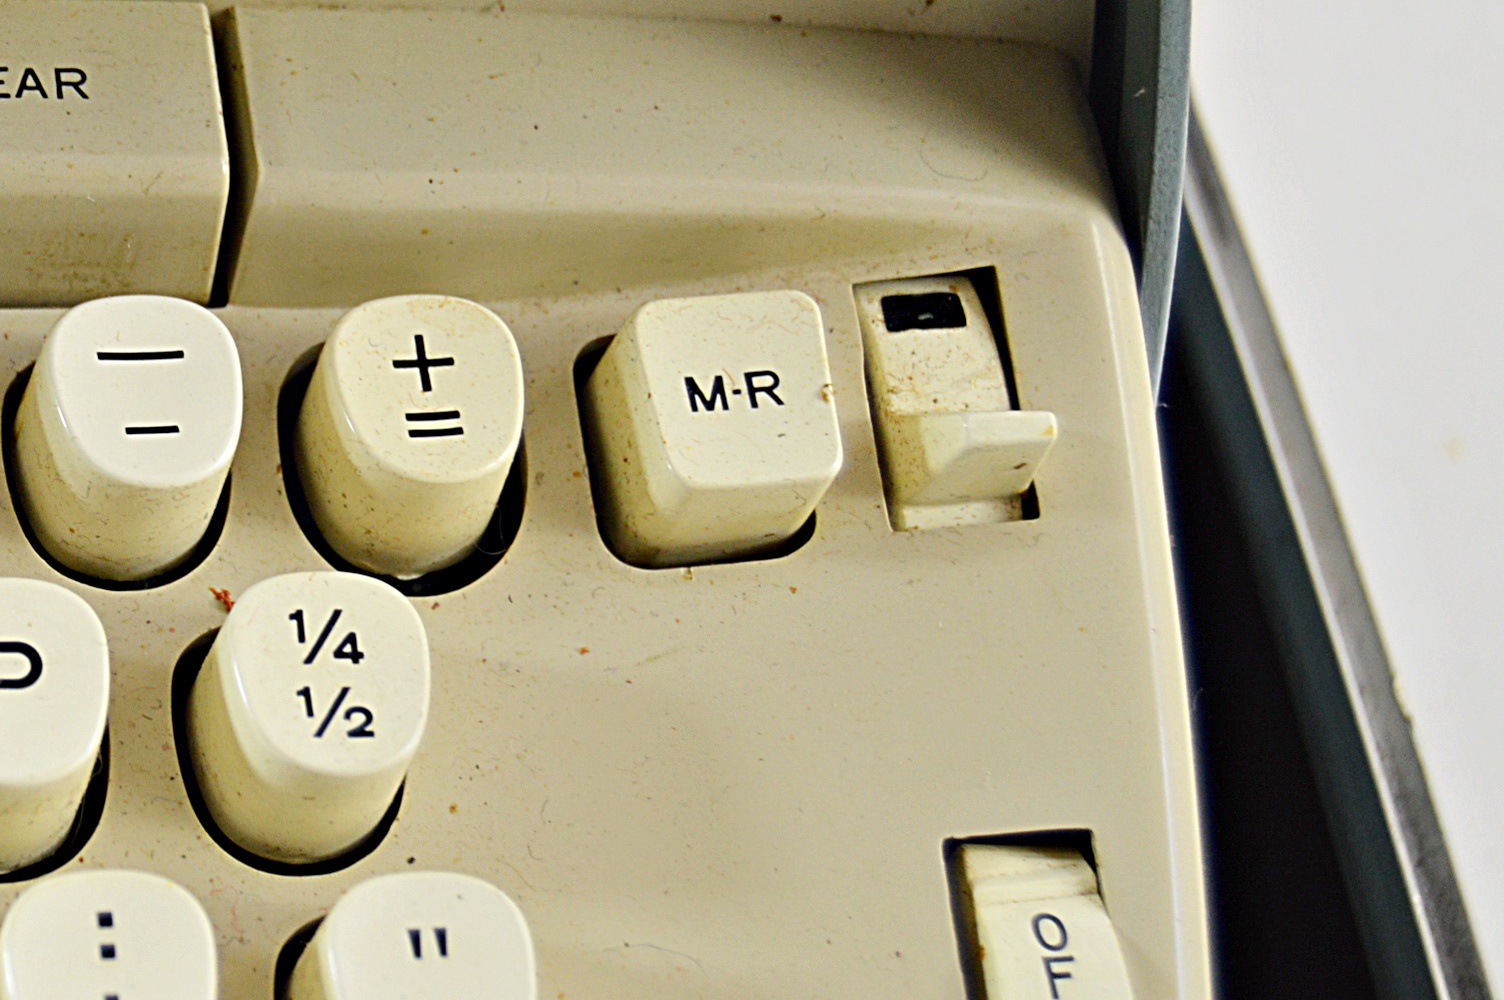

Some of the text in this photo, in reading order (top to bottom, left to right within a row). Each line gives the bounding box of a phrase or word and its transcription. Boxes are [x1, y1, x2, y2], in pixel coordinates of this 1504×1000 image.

[392, 334, 456, 393] +
[683, 370, 786, 413] M-R
[404, 409, 466, 438] =
